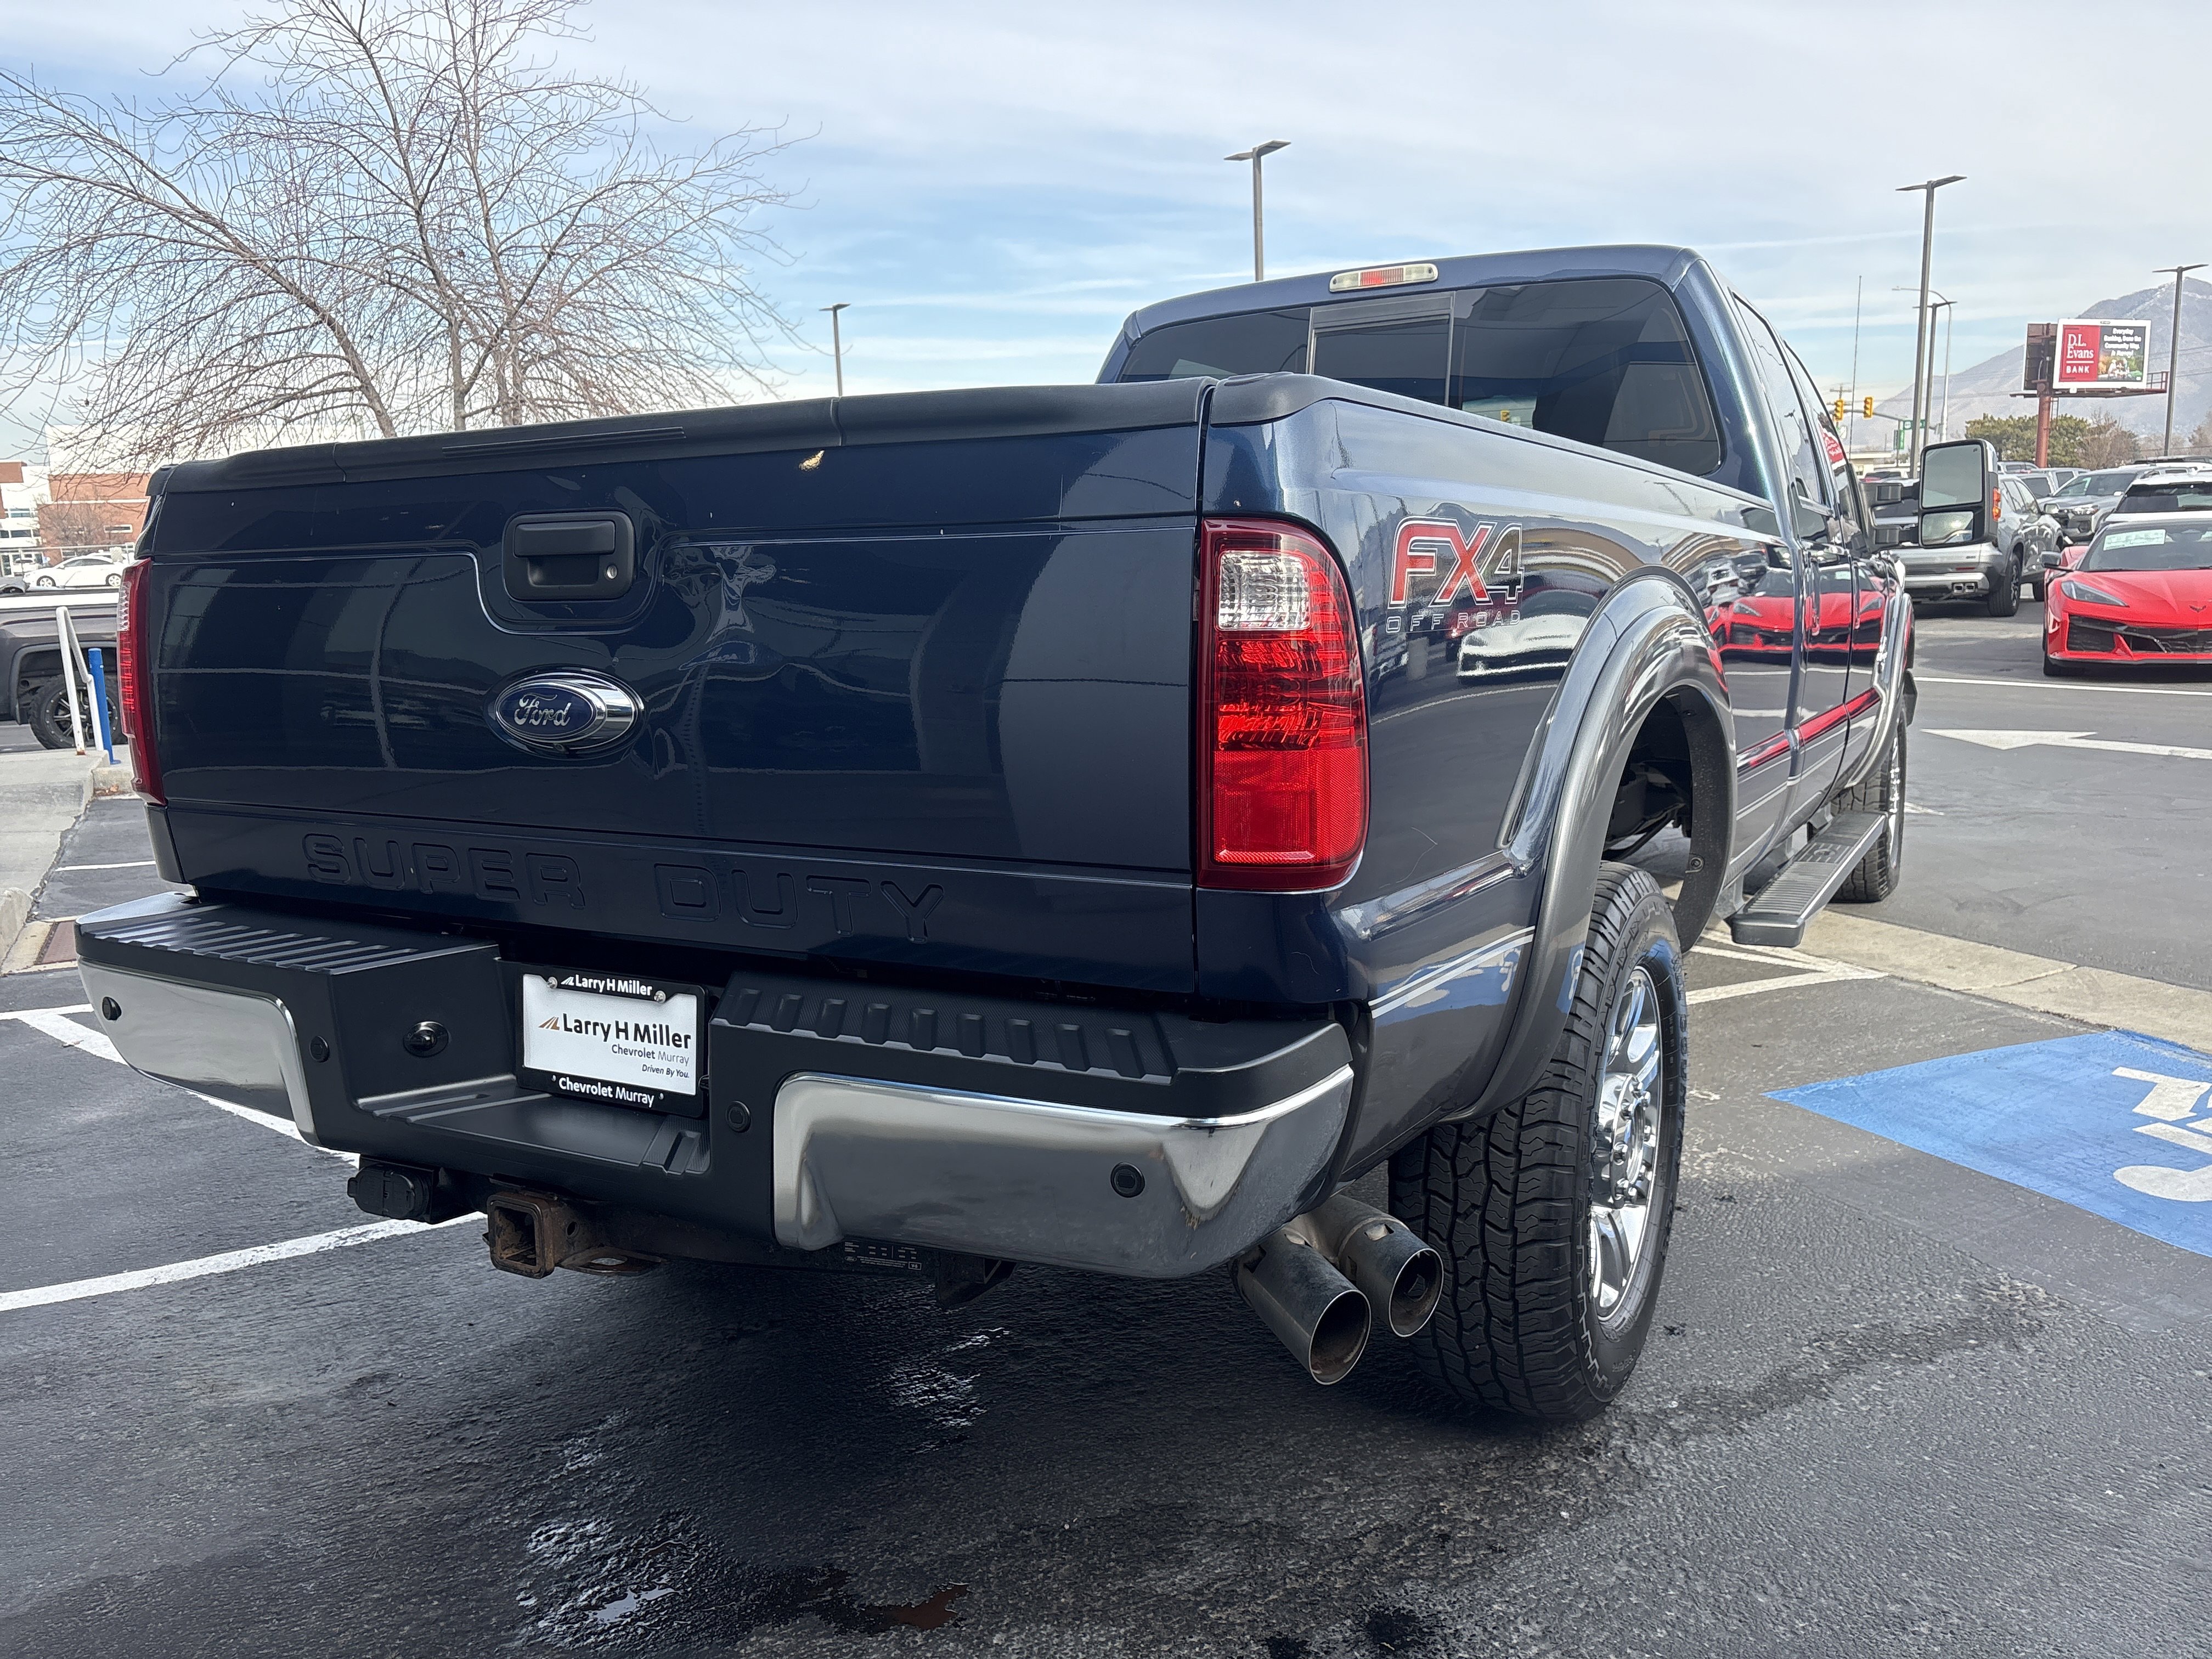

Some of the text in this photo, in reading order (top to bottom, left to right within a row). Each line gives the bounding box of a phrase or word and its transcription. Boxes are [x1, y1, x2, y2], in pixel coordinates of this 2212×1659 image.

[2068, 334, 2086, 346] D.L.
[2067, 346, 2094, 359] Evans
[1387, 515, 1525, 610] FX4
[1385, 610, 1521, 634] OFF ROAD
[514, 692, 572, 727] Ford
[300, 832, 945, 944] SUPER DUTY
[575, 974, 653, 996] Larry H Miller
[562, 1013, 692, 1049] Larry H Miller
[611, 1044, 690, 1066] Chevrolet Murray
[641, 1064, 690, 1078] Driven By You.
[558, 1077, 654, 1108] Chevrolet Murray
